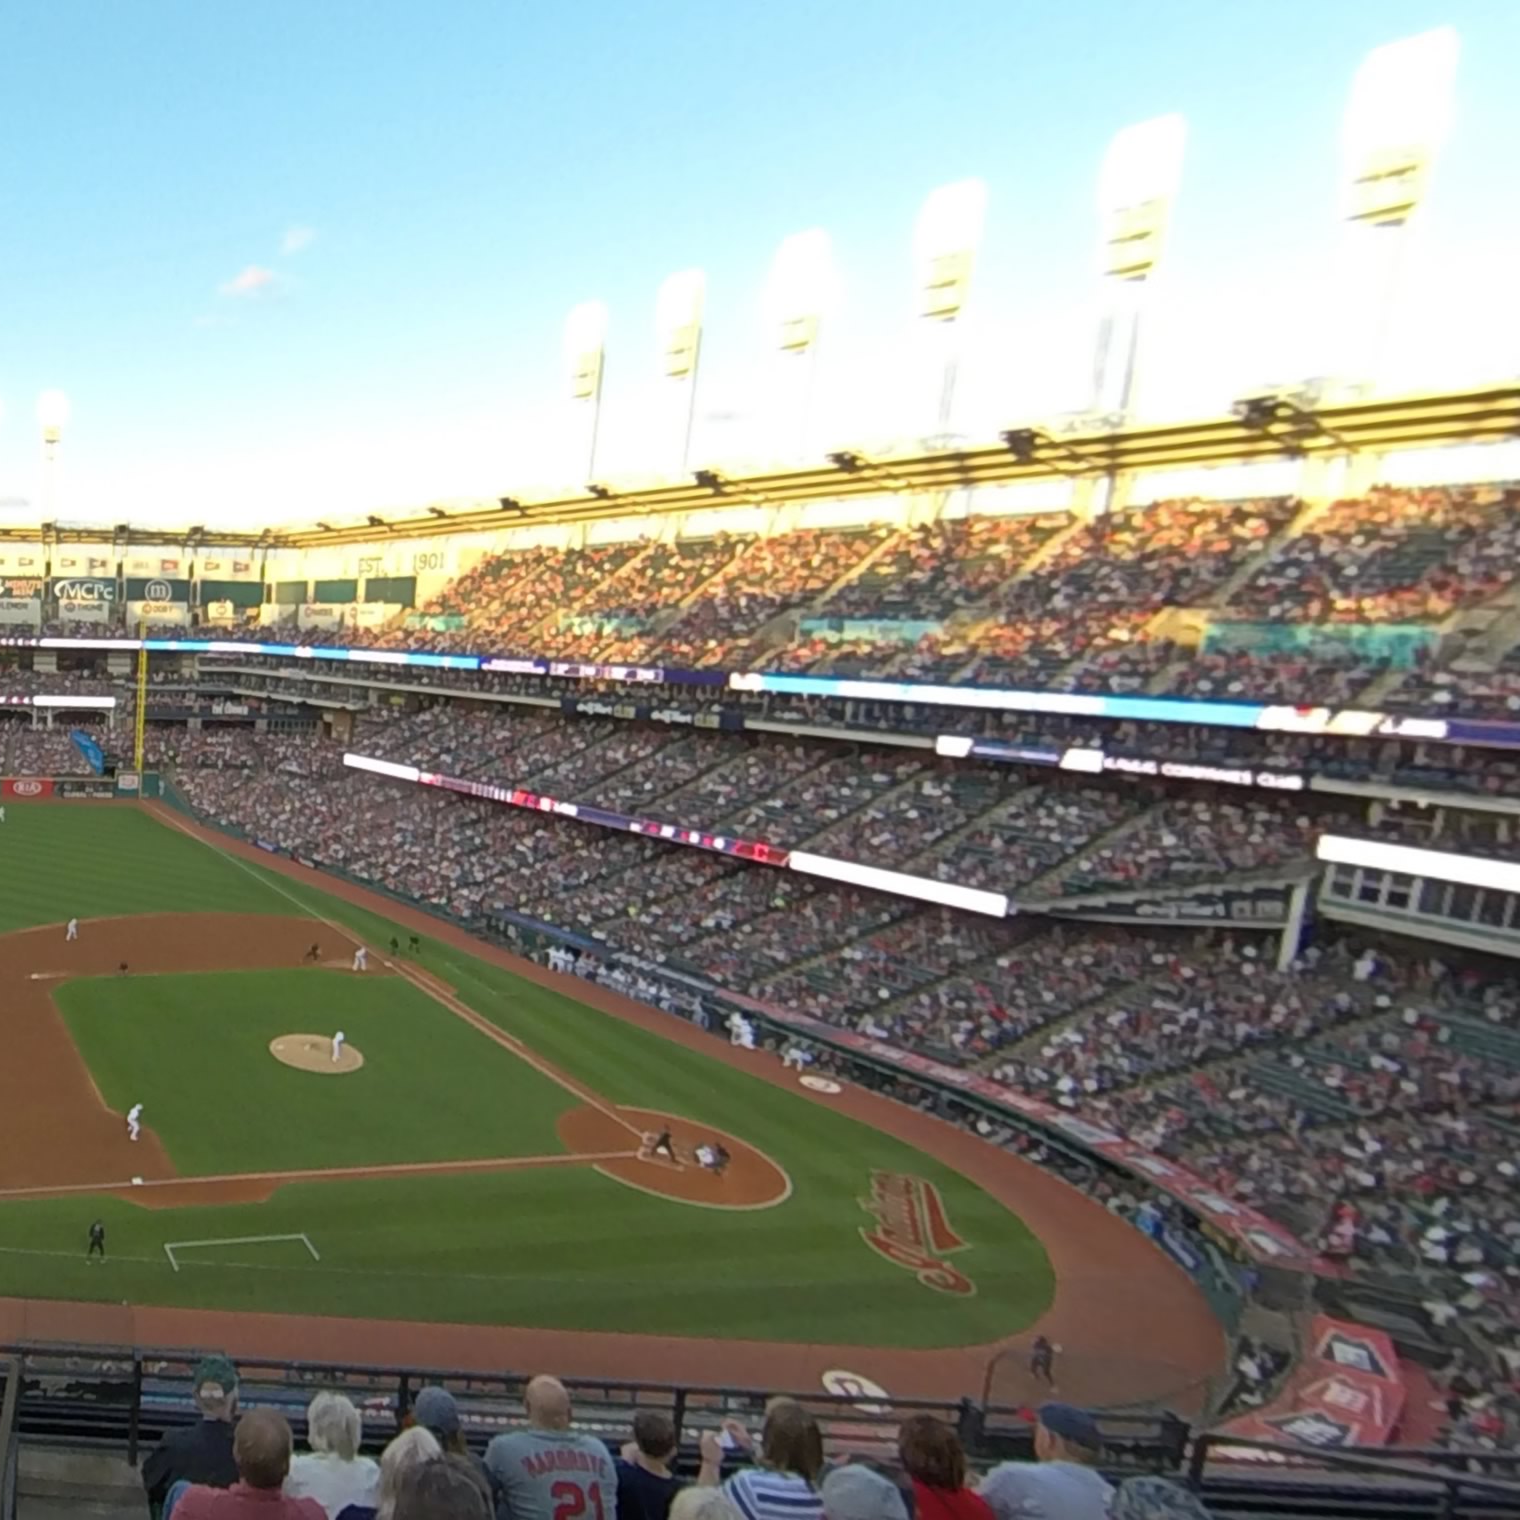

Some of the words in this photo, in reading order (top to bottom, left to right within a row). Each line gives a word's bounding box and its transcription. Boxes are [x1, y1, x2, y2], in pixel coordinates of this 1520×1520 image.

[413, 552, 445, 575] 1901
[17, 782, 39, 793] KIA
[550, 1480, 606, 1520] 21
